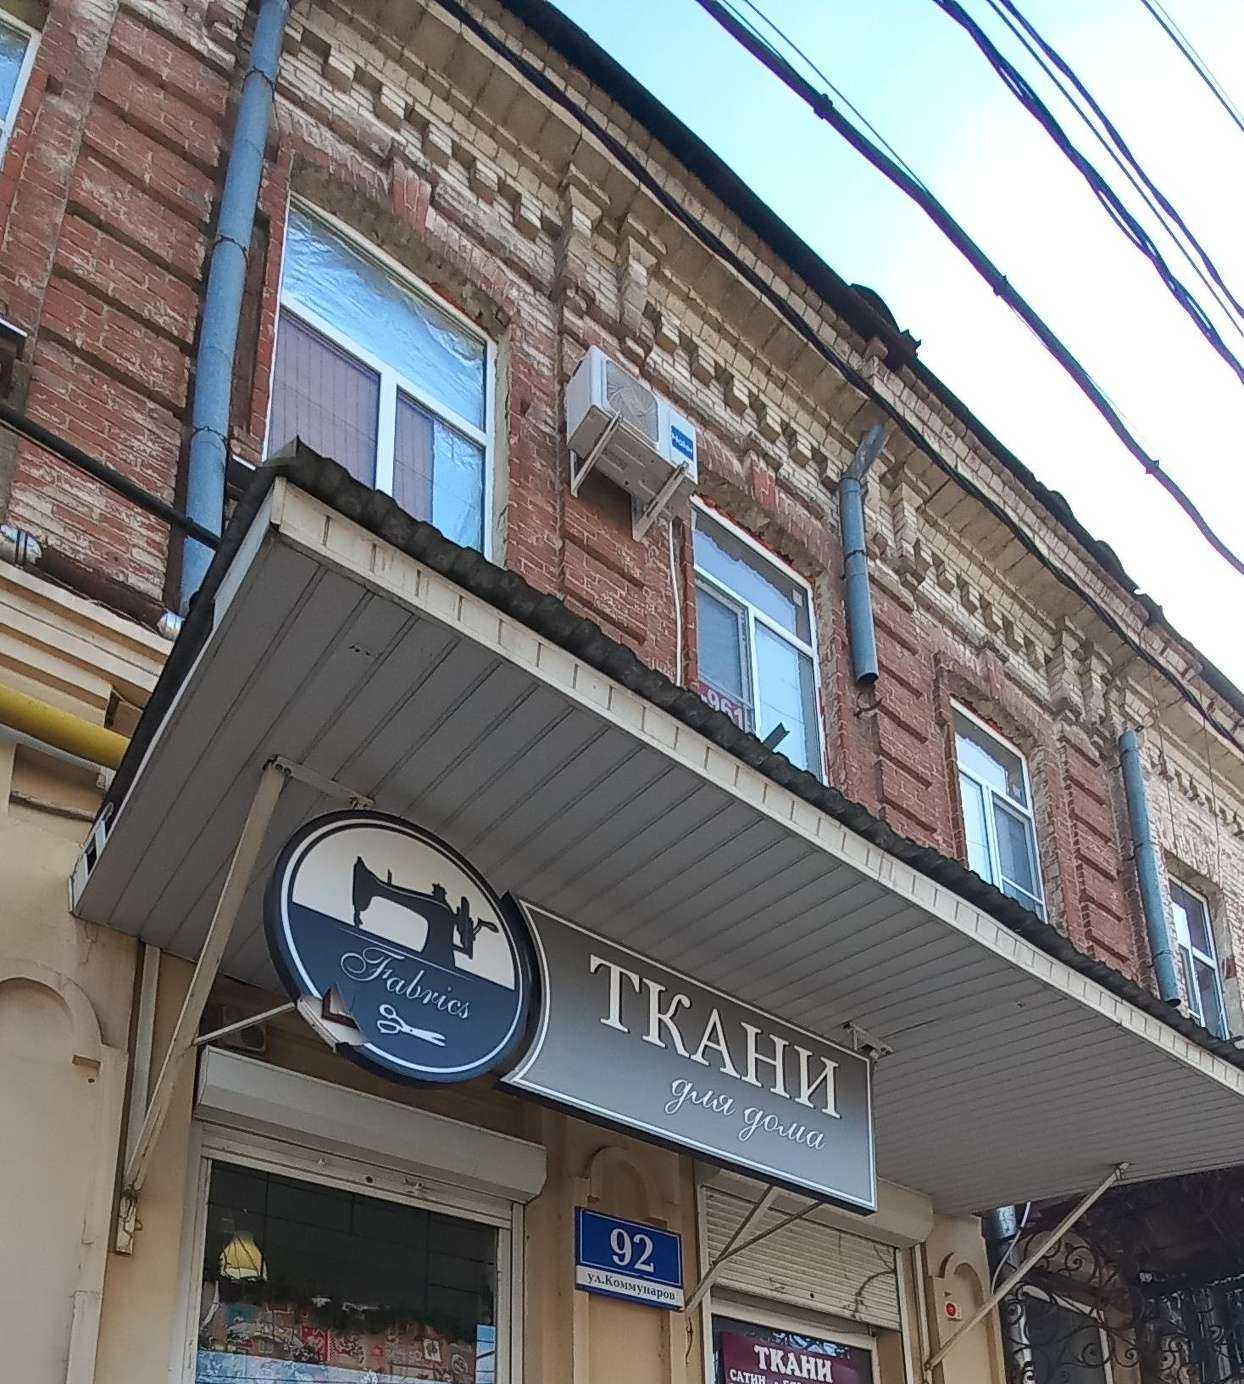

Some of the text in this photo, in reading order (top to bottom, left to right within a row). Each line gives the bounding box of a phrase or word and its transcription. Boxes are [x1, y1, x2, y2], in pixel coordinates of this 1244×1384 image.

[340, 946, 470, 1019] Fabrics
[590, 954, 842, 1119] ТКАНИ
[664, 1079, 826, 1150] для дома
[610, 1228, 655, 1273] 92
[587, 1272, 677, 1301] ул.Коммунаров
[754, 1344, 834, 1384] ТКАНИ
